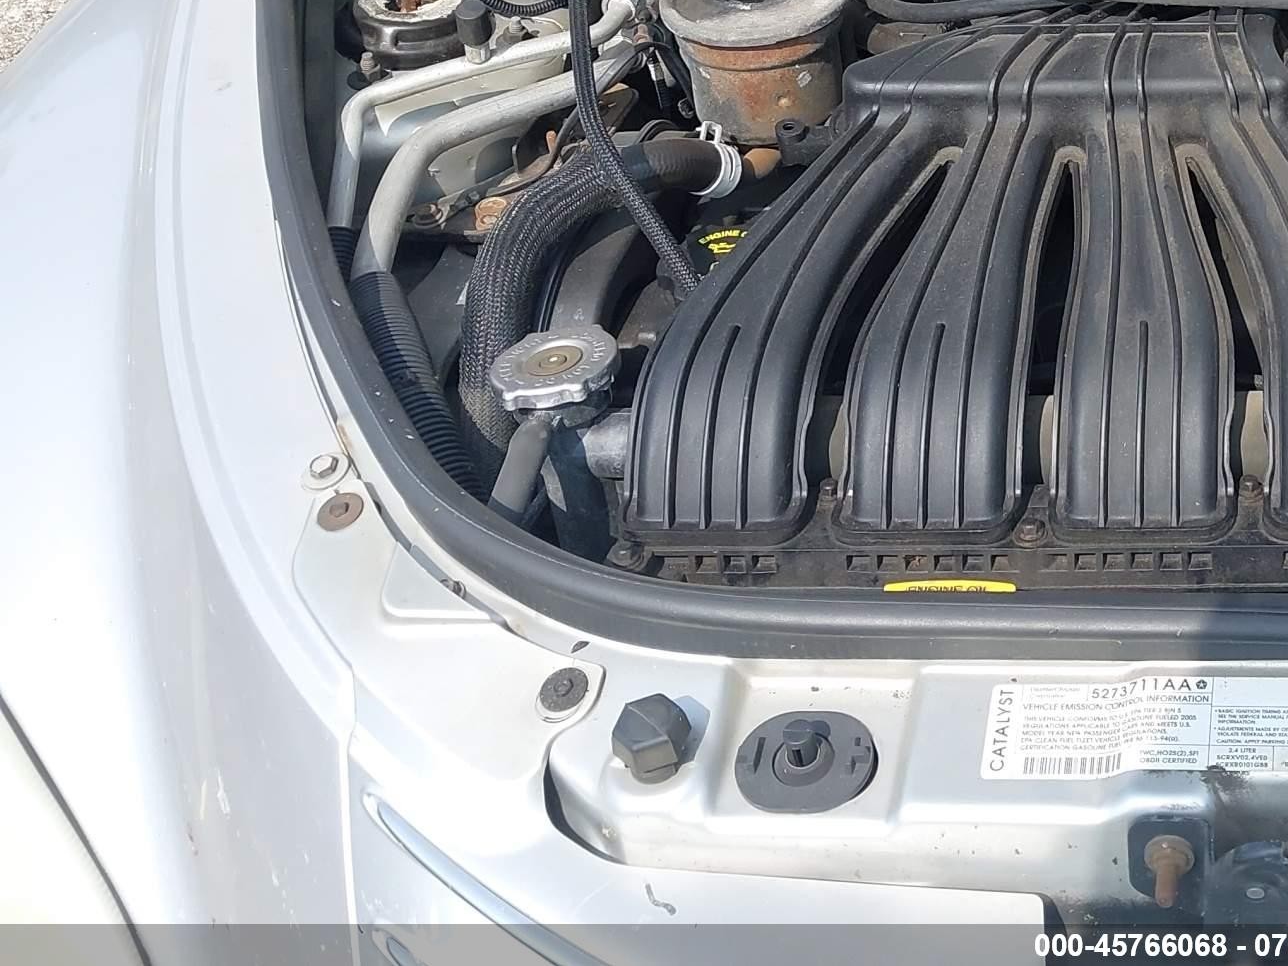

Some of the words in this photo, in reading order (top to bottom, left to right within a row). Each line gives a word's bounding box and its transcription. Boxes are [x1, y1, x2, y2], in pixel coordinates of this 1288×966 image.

[698, 229, 741, 245] ENGINE
[1091, 677, 1192, 700] 5273711AA
[1022, 702, 1058, 711] VEHICLE
[1060, 702, 1103, 711] EMISSION
[1104, 696, 1144, 711] CONTROL
[1146, 694, 1210, 703] INFORMATION
[990, 689, 1015, 772] CATALYST
